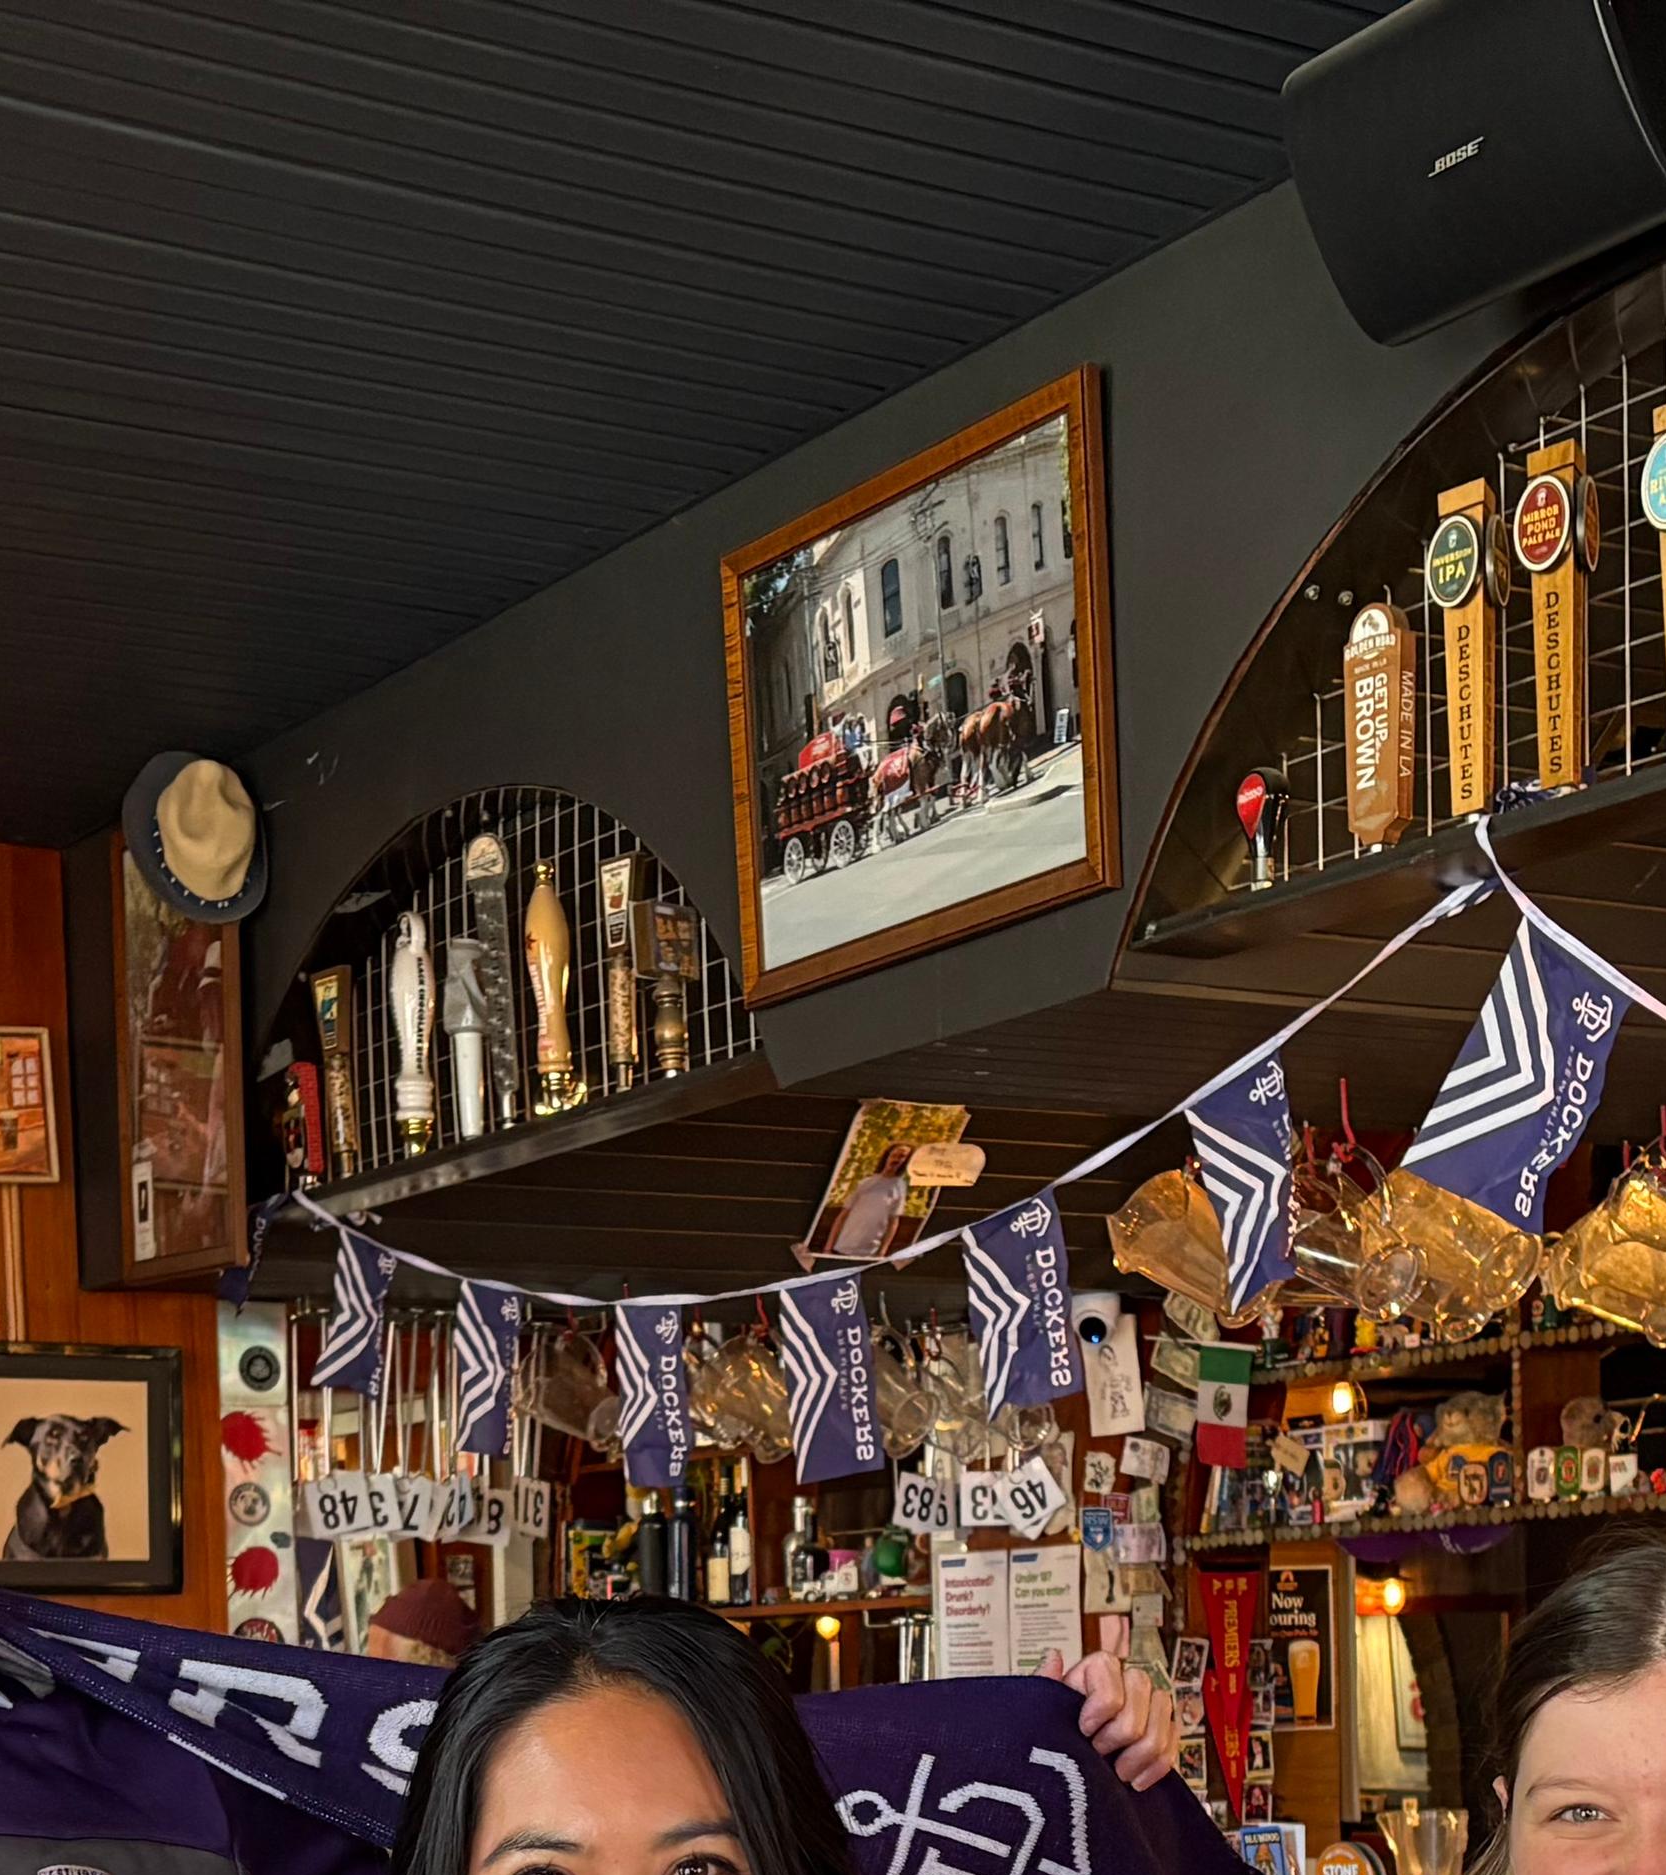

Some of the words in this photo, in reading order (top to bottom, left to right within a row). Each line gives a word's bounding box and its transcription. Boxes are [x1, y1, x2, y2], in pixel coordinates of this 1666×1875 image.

[1428, 135, 1484, 178] BOSE
[1522, 506, 1560, 524] MIRROR
[1521, 532, 1544, 548] PALE
[1545, 527, 1561, 541] ALE
[1527, 519, 1556, 536] POND
[1433, 547, 1473, 568] INVERSION
[1438, 566, 1467, 585] IPA
[1372, 672, 1388, 712] GET
[1545, 591, 1562, 774] DESCHUTES
[1400, 670, 1415, 722] MADE
[1456, 624, 1473, 800] DESCHUTES
[1355, 678, 1376, 791] BROWN
[1376, 714, 1389, 744] UP
[1400, 728, 1414, 750] IN
[1399, 758, 1413, 778] LA
[901, 1482, 934, 1526] 83
[1009, 1478, 1048, 1519] 46
[318, 1489, 358, 1530] 48
[944, 1575, 994, 1590] Intoxicated?
[1014, 1571, 1039, 1584] Under
[945, 1589, 974, 1603] Drunk?
[1014, 1586, 1030, 1598] Can
[1031, 1586, 1047, 1599] you
[1047, 1583, 1071, 1598] enter?
[1271, 1592, 1304, 1609] Now
[945, 1602, 991, 1618] Disorderly?
[1269, 1608, 1317, 1627] ouring
[1224, 1599, 1241, 1668] PREMIERS
